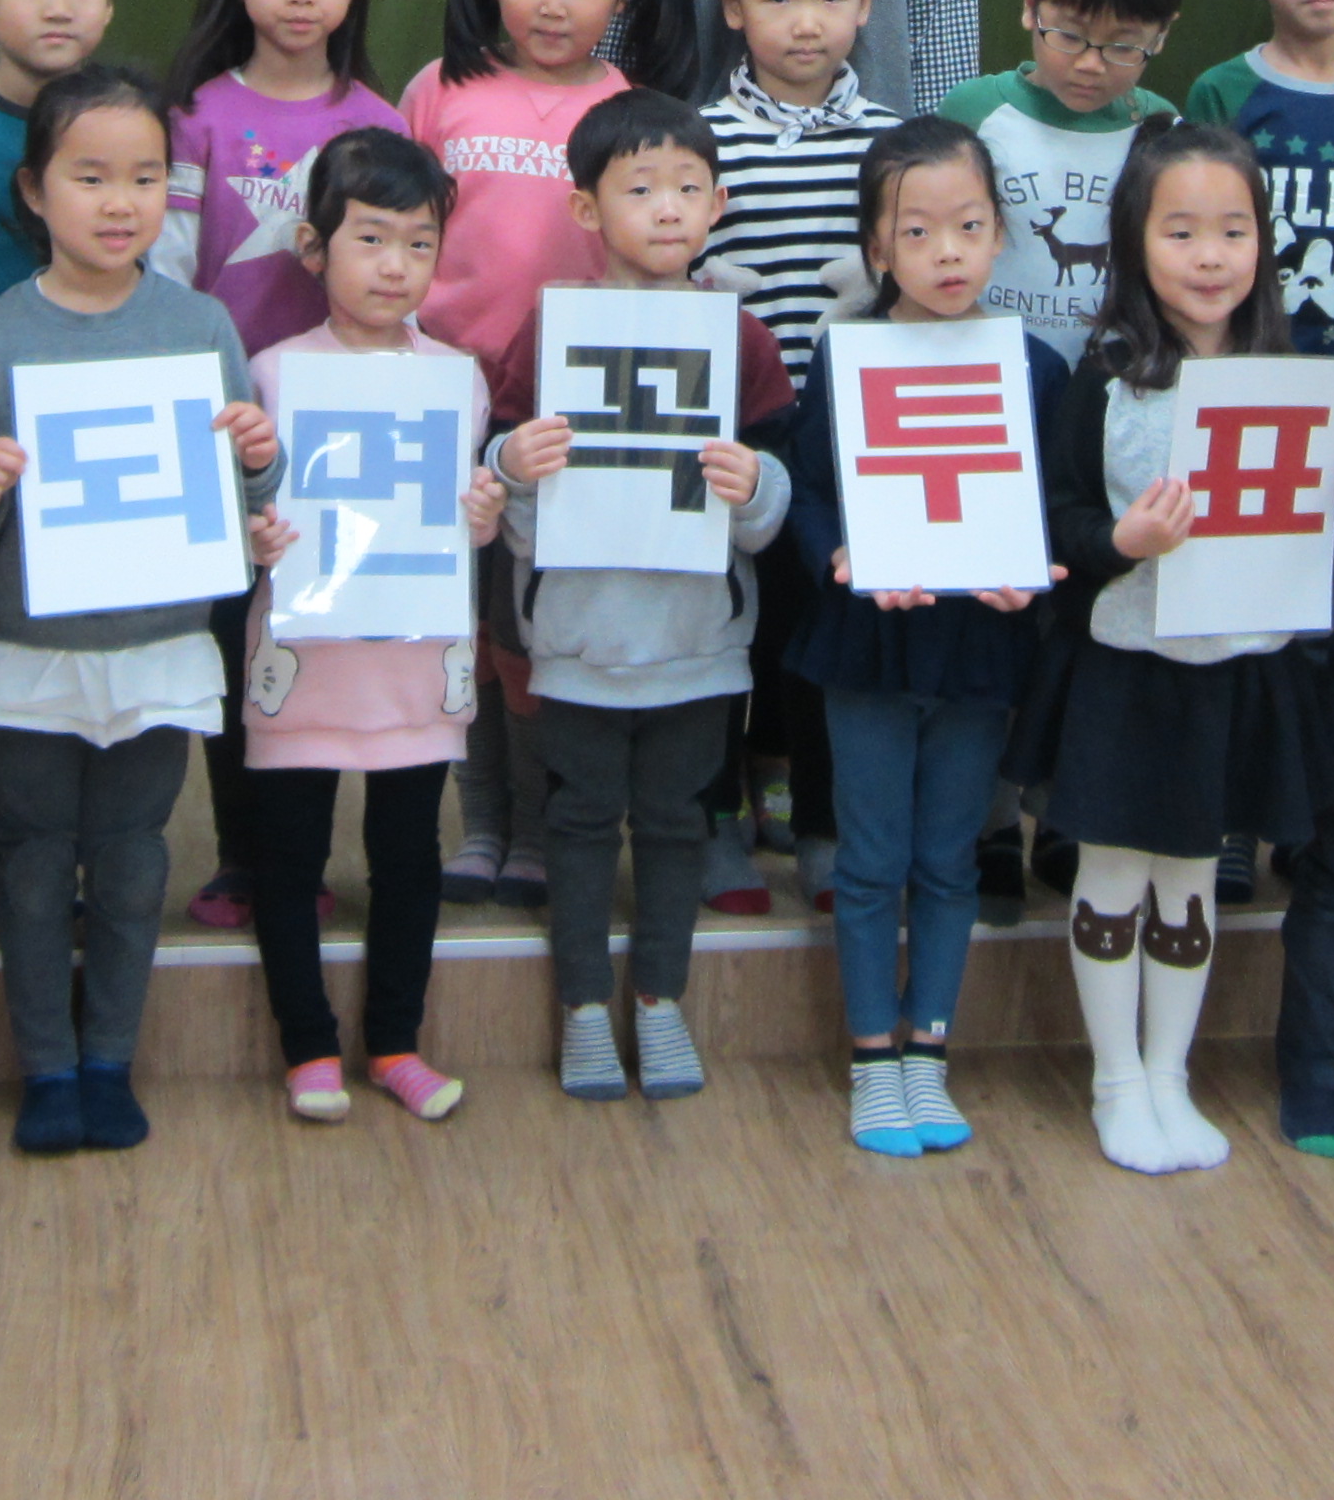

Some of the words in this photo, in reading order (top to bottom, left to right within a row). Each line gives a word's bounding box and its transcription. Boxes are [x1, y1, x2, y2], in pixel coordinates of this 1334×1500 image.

[241, 178, 308, 217] DYNA
[988, 285, 1081, 317] GENTLE
[35, 397, 226, 545] 되
[290, 409, 460, 575] 면
[555, 344, 721, 513] 꼭
[855, 363, 1023, 523] 투
[1188, 405, 1330, 537] 표
